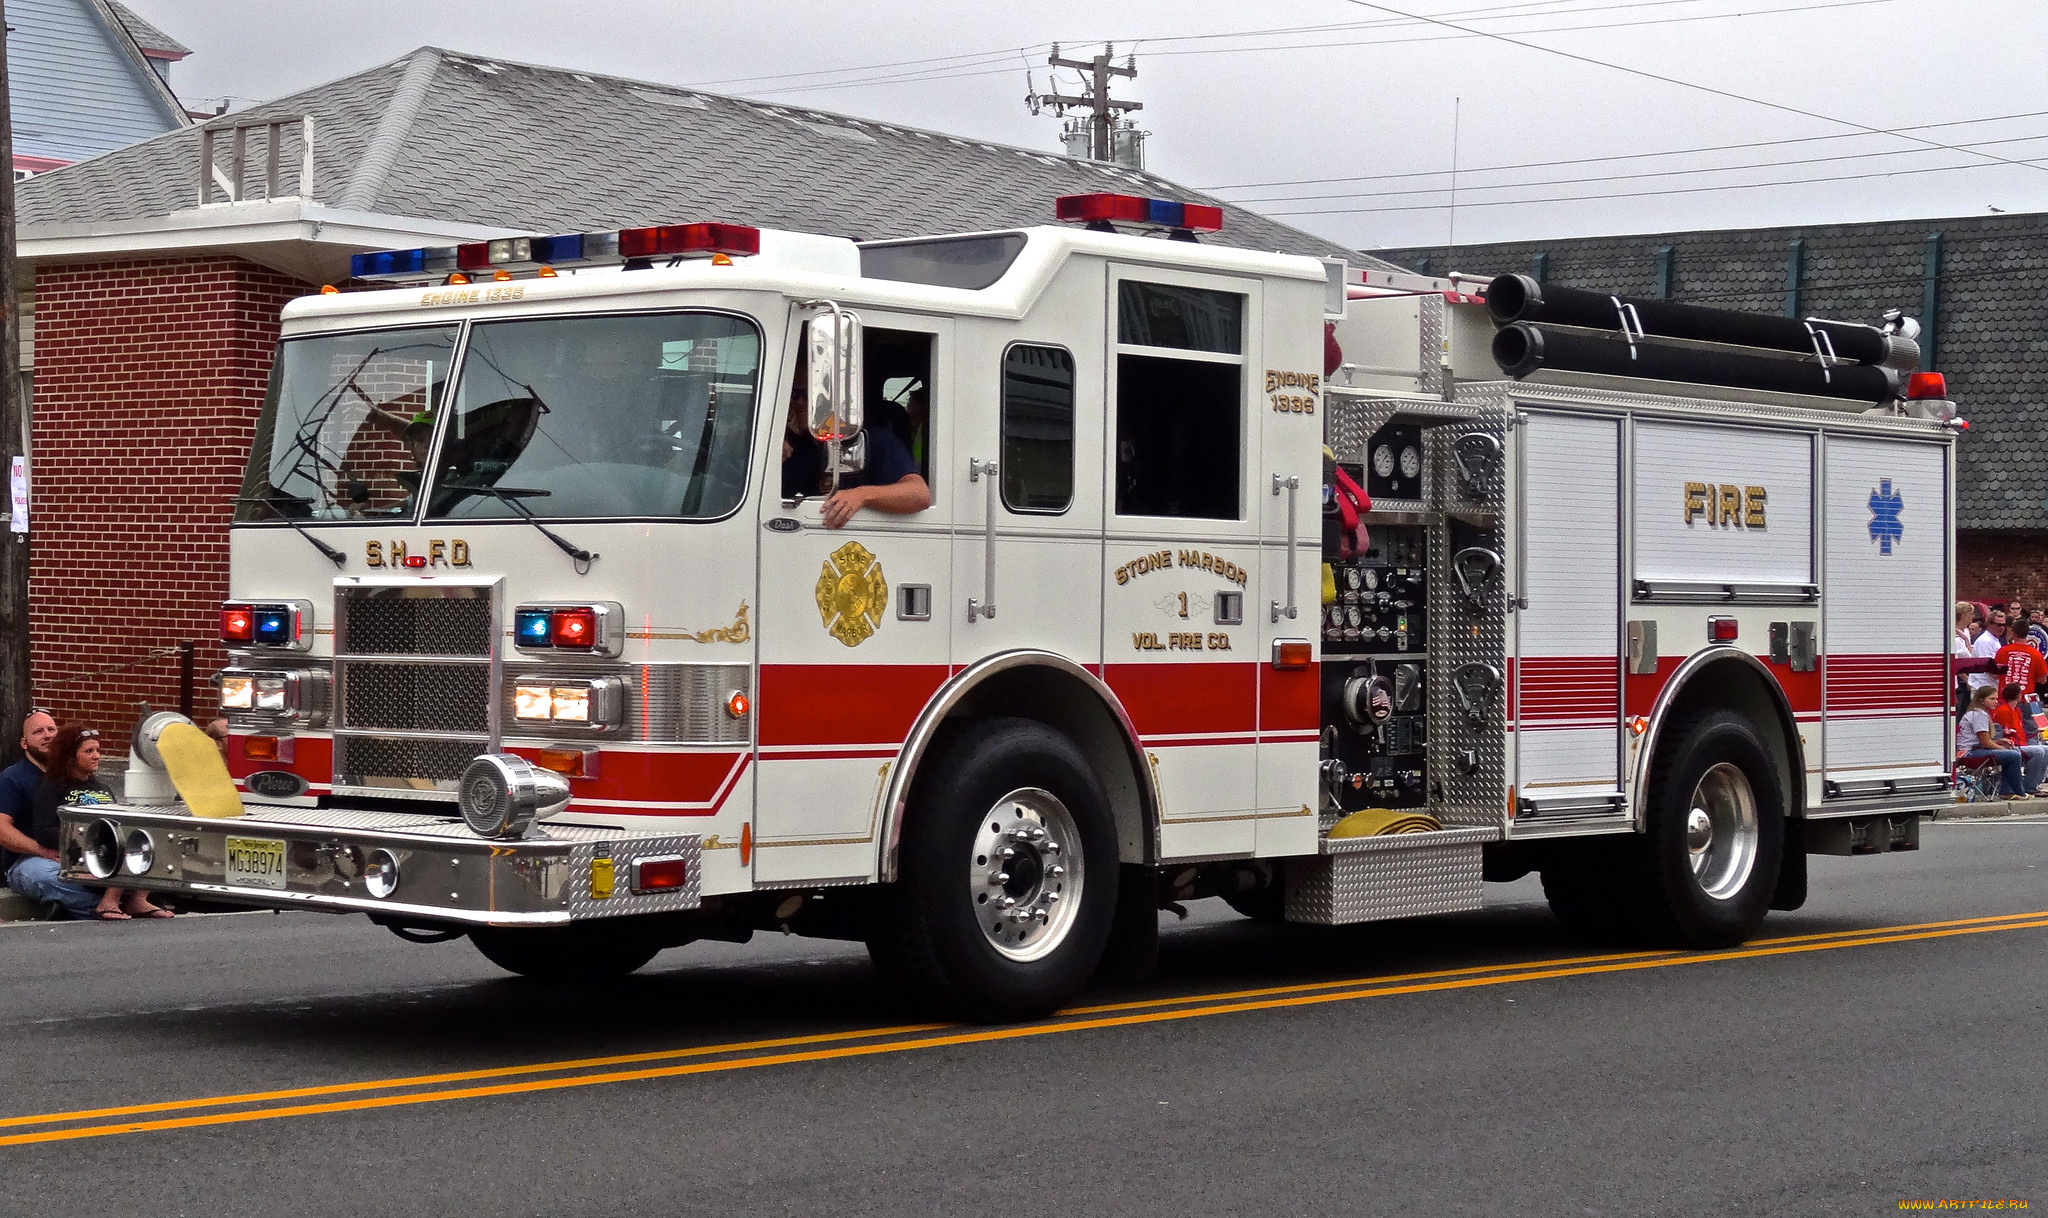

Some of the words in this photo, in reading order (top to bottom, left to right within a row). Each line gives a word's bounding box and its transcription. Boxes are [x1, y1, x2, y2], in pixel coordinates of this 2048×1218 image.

[421, 289, 480, 306] ENGINE
[1265, 369, 1319, 397] ENGINE
[1271, 394, 1315, 415] 1336
[1684, 482, 1767, 529] FIRE
[839, 552, 867, 565] STONE
[1114, 550, 1173, 586] STONE
[1178, 549, 1248, 590] HARBOR
[1177, 591, 1189, 618] 1
[835, 623, 869, 638] HARBOR
[1131, 632, 1166, 651] VOL.
[1168, 632, 1203, 651] FIRE
[1207, 632, 1232, 651] CO.
[228, 848, 283, 877] MG38974
